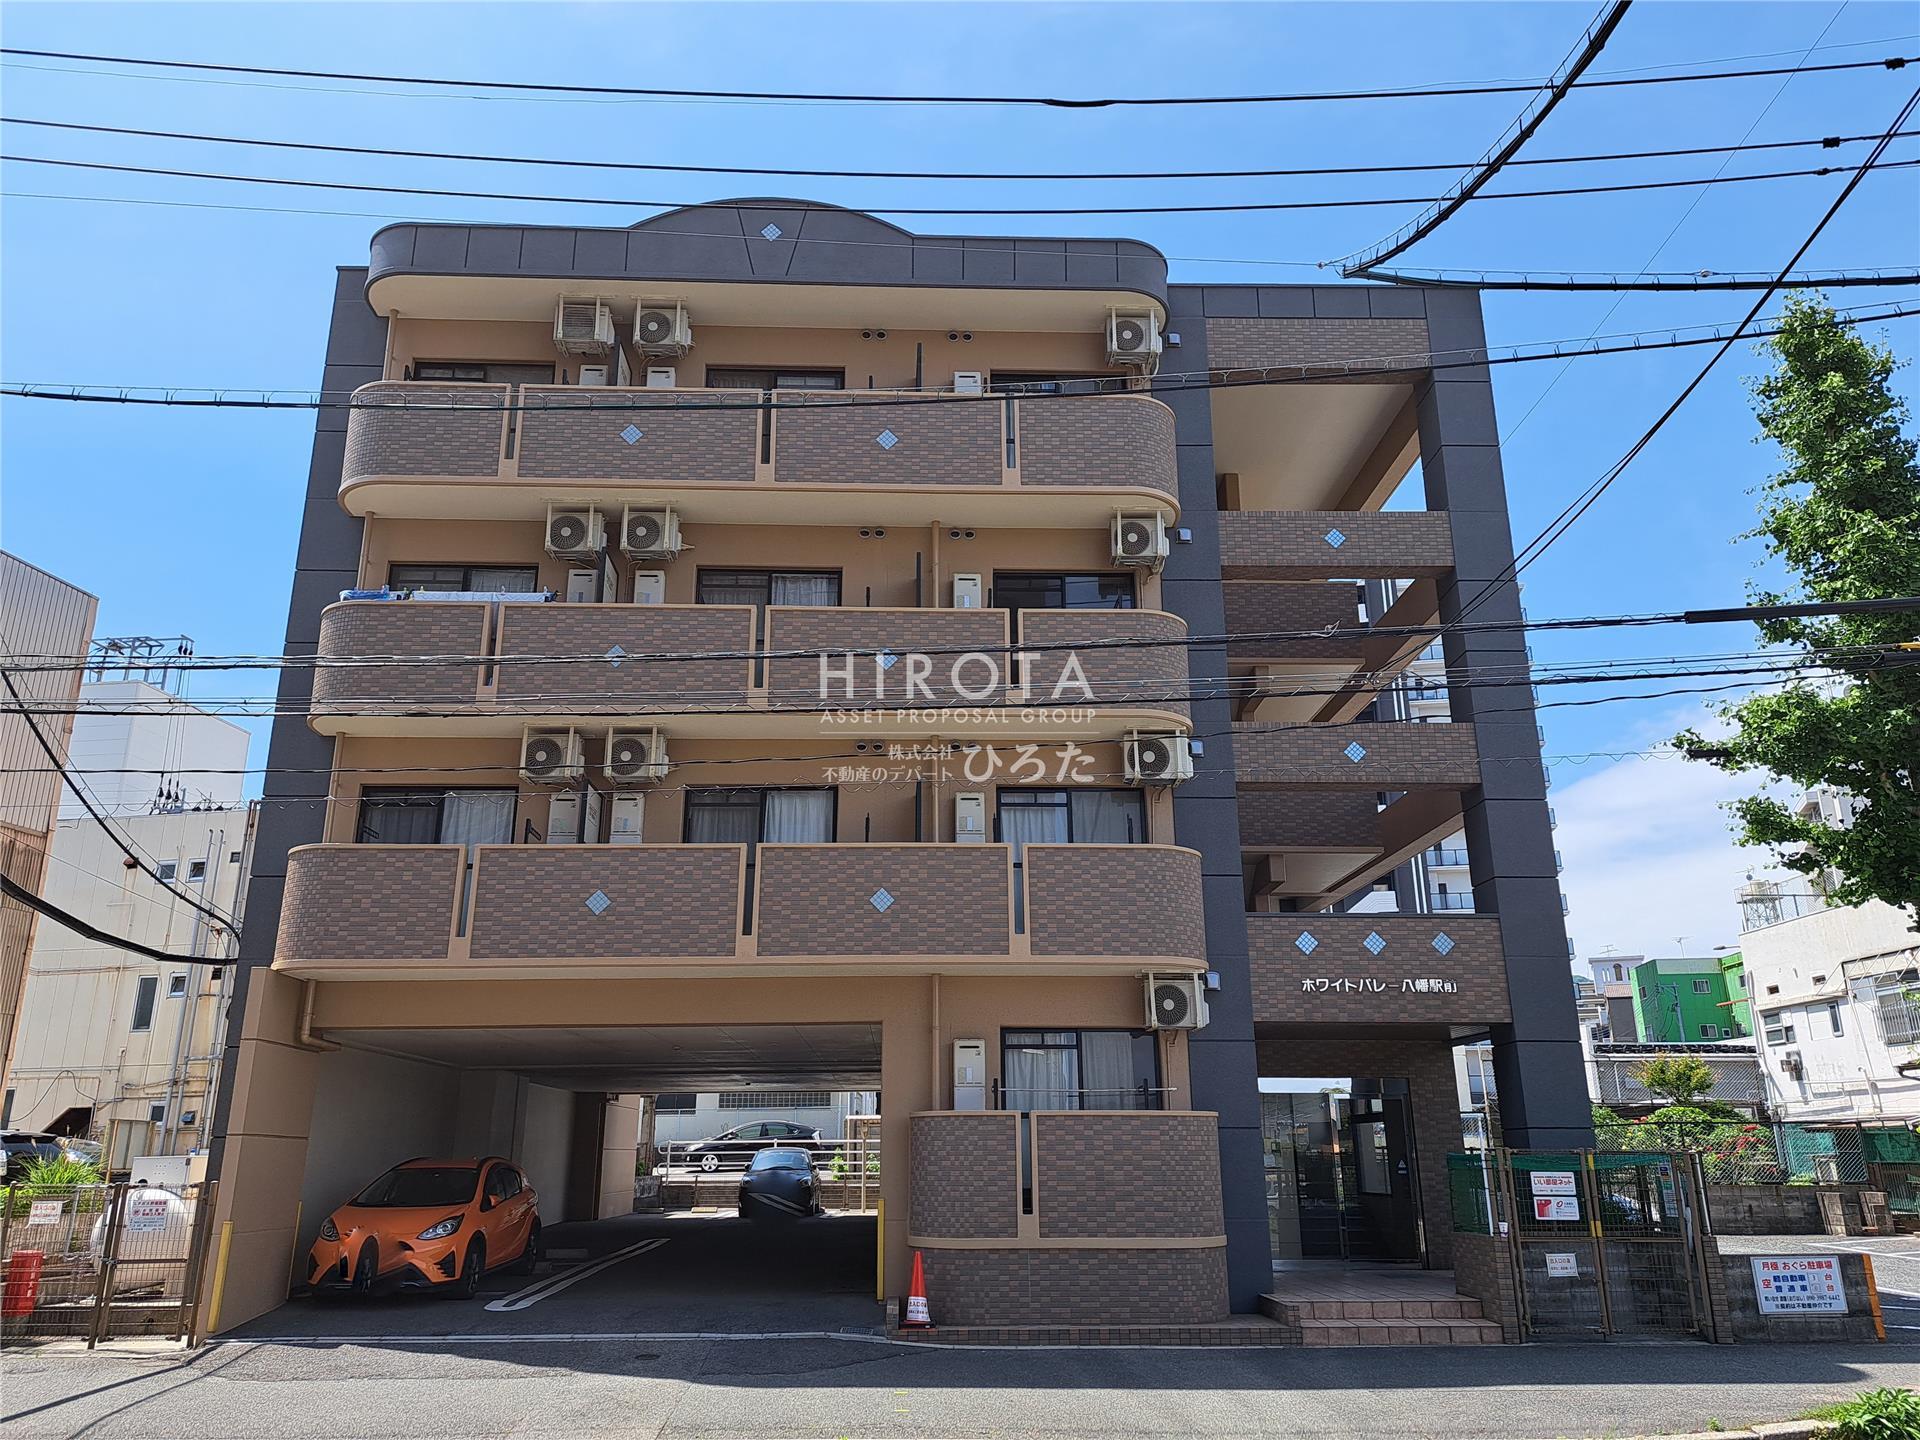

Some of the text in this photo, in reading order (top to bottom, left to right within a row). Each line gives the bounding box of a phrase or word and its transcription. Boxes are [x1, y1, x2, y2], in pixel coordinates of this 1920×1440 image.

[1762, 1260, 1833, 1271] 月極 おぐら駐車場
